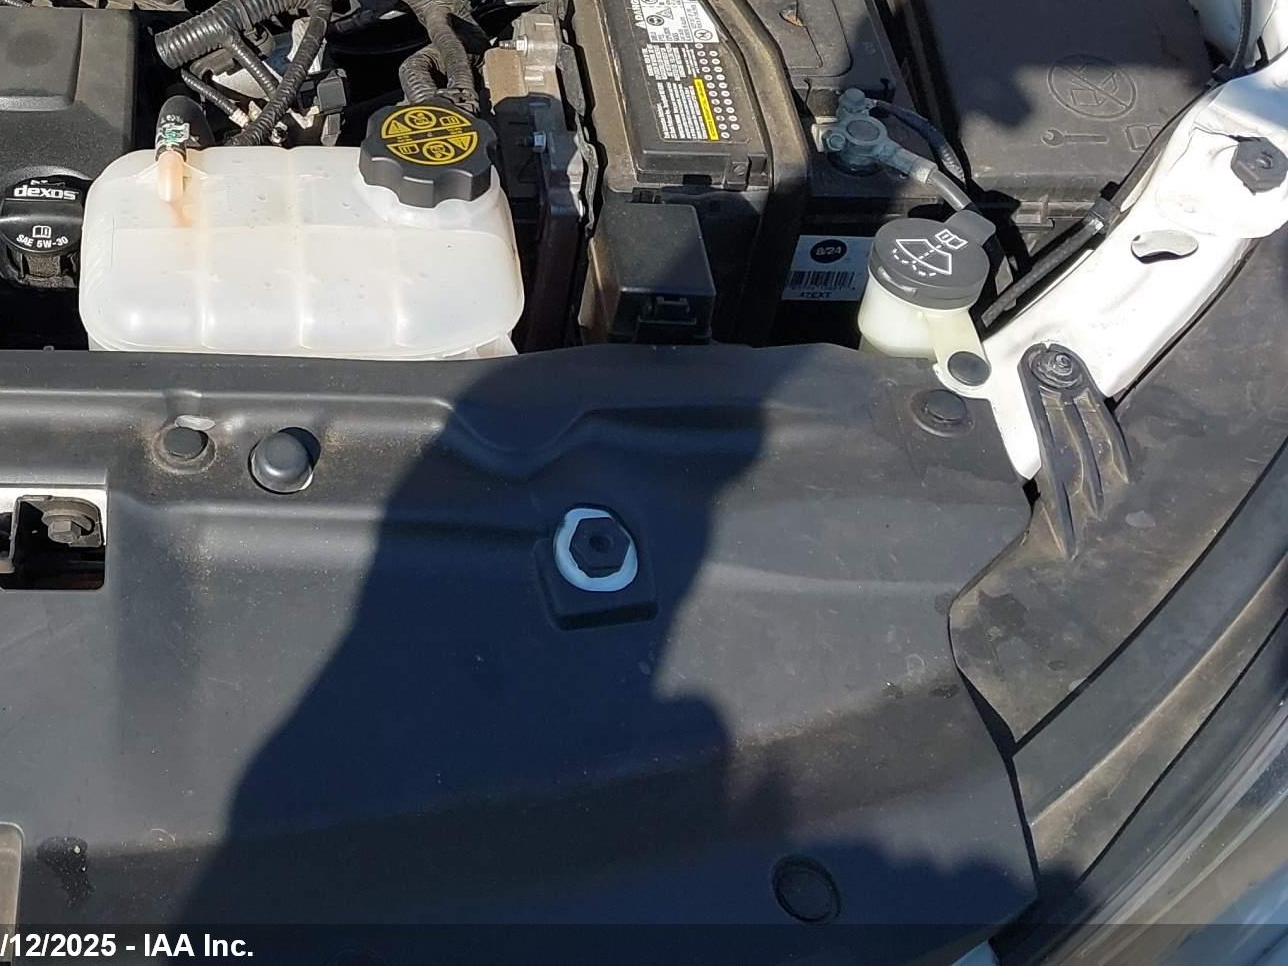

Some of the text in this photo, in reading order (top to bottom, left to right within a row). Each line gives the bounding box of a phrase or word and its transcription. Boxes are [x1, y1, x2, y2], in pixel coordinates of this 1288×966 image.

[14, 185, 78, 200] dexos
[16, 234, 68, 248] SAE 5W-30
